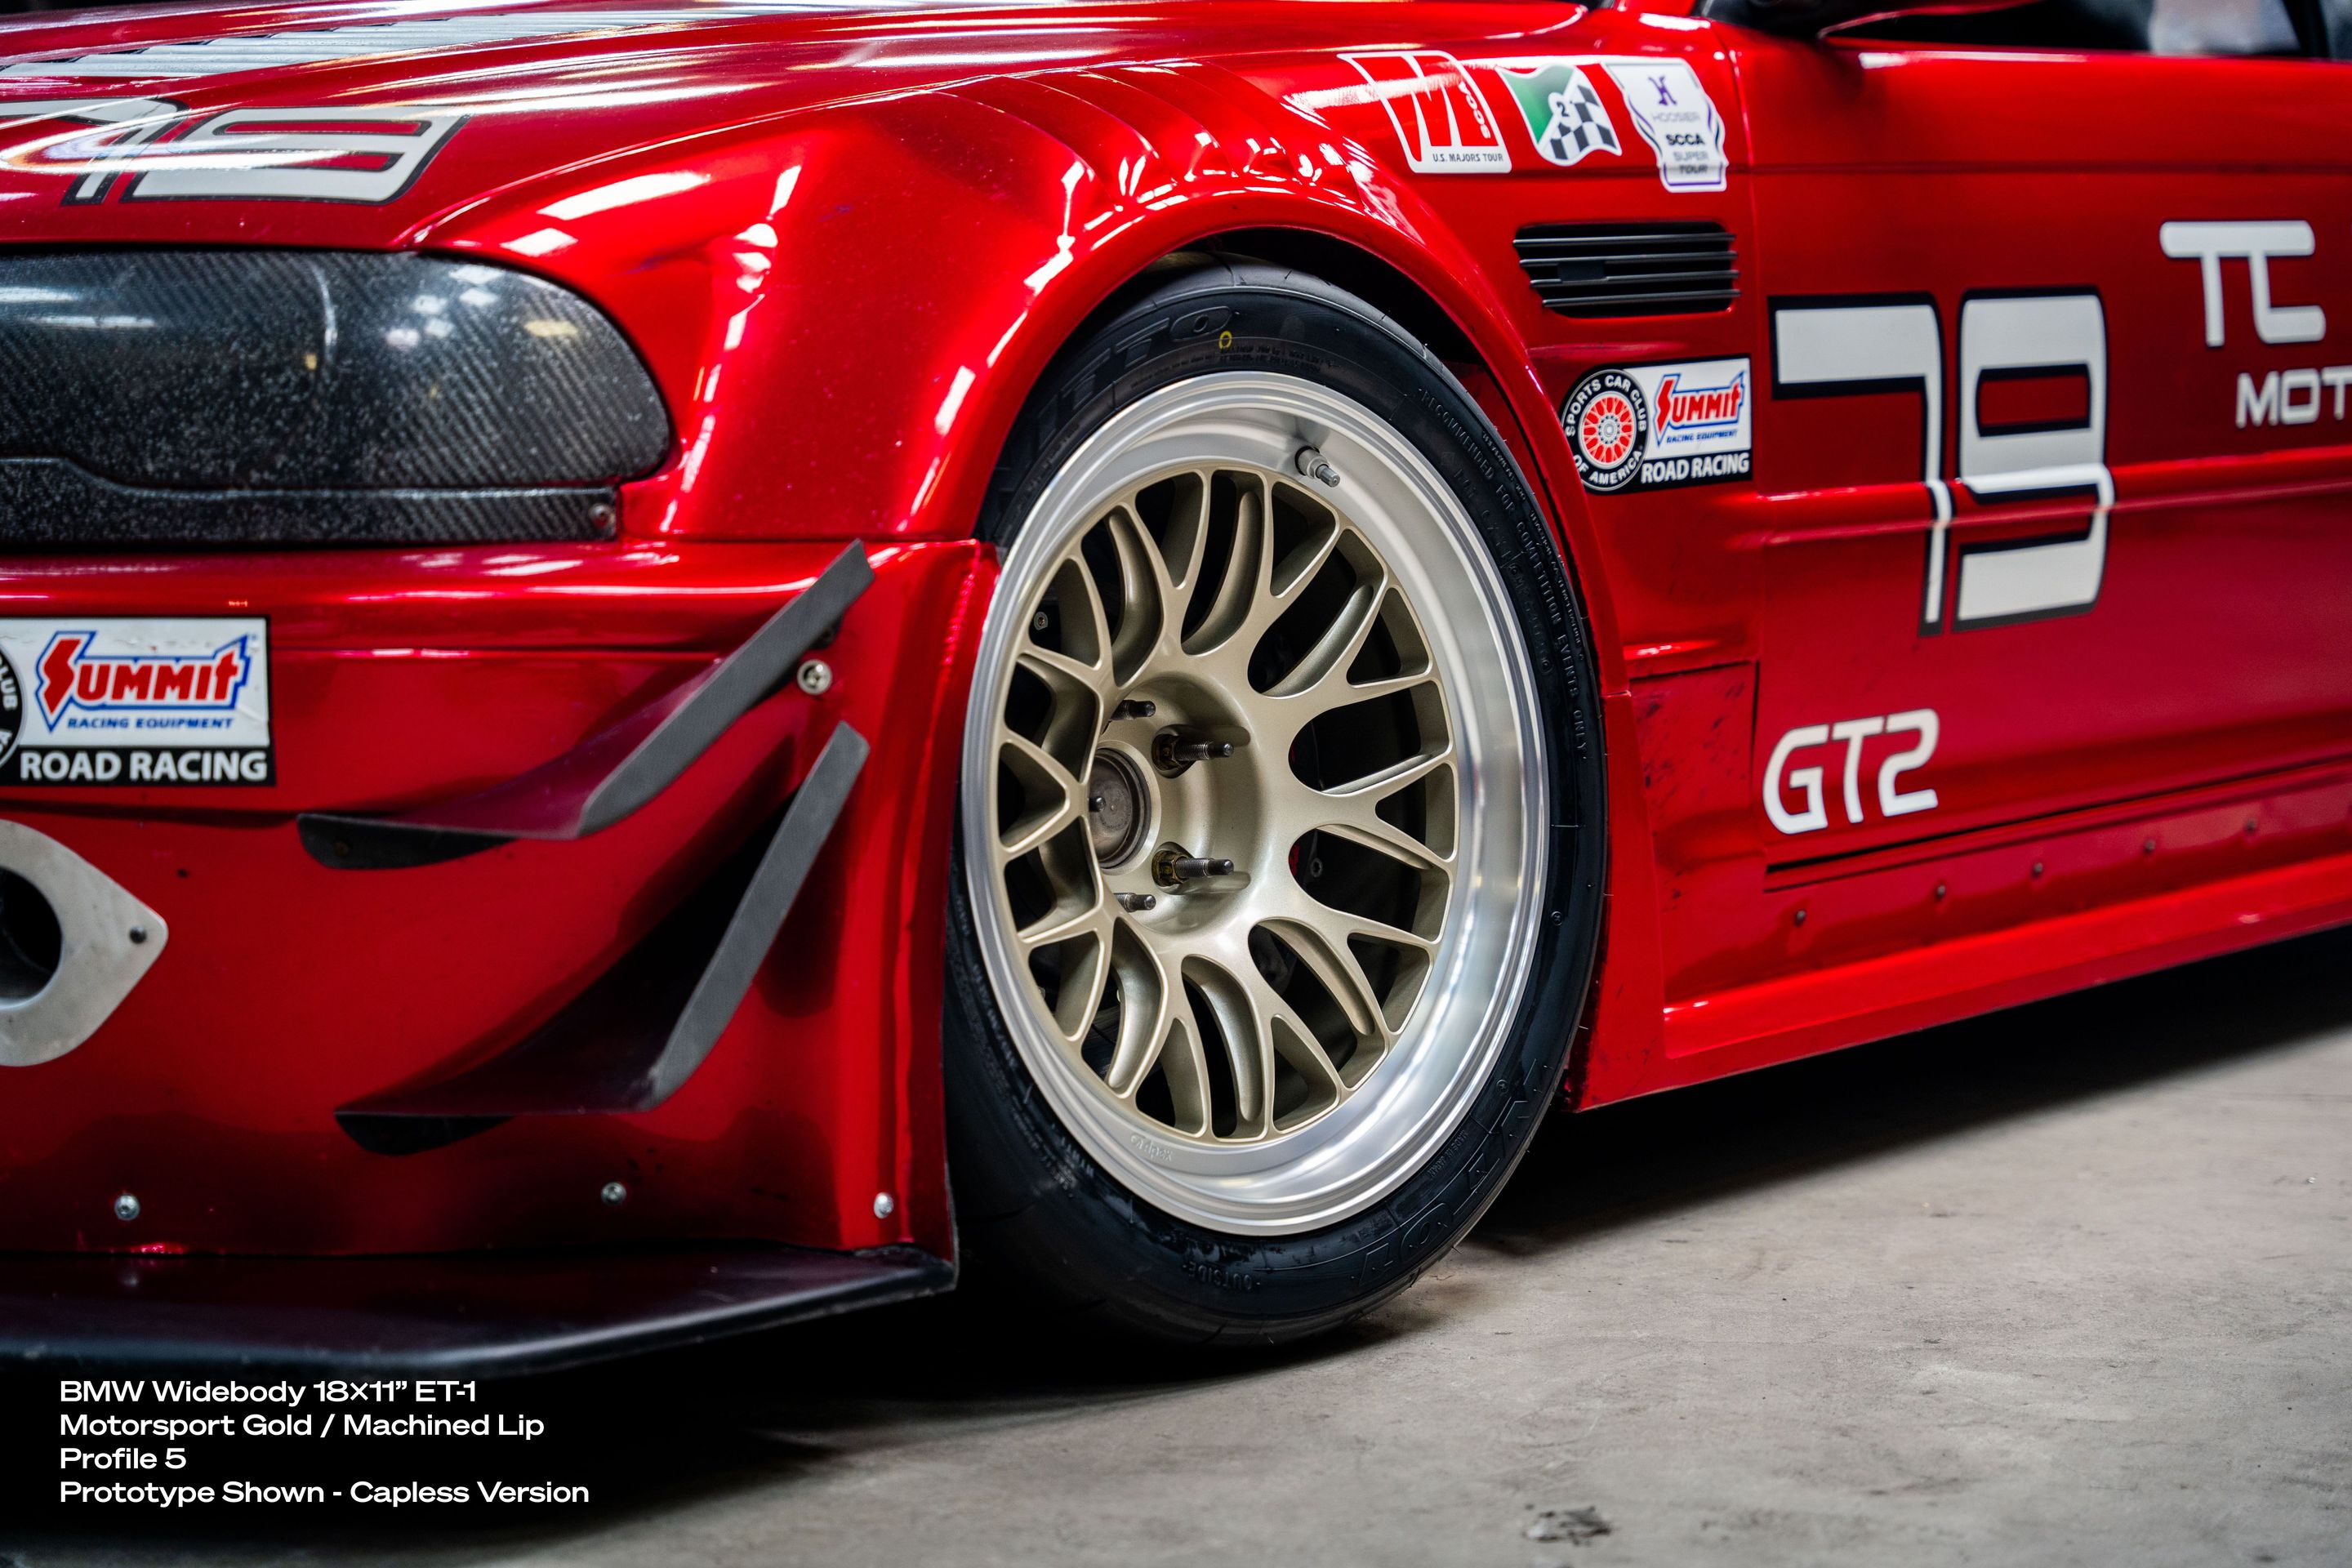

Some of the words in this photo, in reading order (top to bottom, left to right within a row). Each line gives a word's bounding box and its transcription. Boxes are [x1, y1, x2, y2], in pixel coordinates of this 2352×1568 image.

[1555, 100, 1570, 118] 2
[1665, 133, 1706, 146] SCCA
[1432, 153, 1448, 163] U.S.
[1450, 153, 1481, 163] MAJORS
[1482, 153, 1504, 163] TOUR
[1678, 163, 1708, 174] TOUR
[1566, 376, 1601, 438] SPORTS
[1605, 374, 1632, 392] CAR
[1630, 389, 1647, 432] CLUB
[1667, 432, 1694, 444] RACING
[1697, 429, 1738, 441] EQUIPMENT
[1573, 454, 1589, 473] OF
[1589, 450, 1642, 486] AMERICA
[1641, 458, 1689, 484] ROAD
[1690, 452, 1750, 479] RACING
[1769, 285, 2115, 635] 79
[0, 653, 18, 710] LUB
[67, 717, 129, 729] RACING
[136, 717, 234, 729] EQUIPMENT
[20, 750, 122, 782] ROAD
[129, 750, 268, 782] RACING
[1762, 707, 1940, 835] GT2
